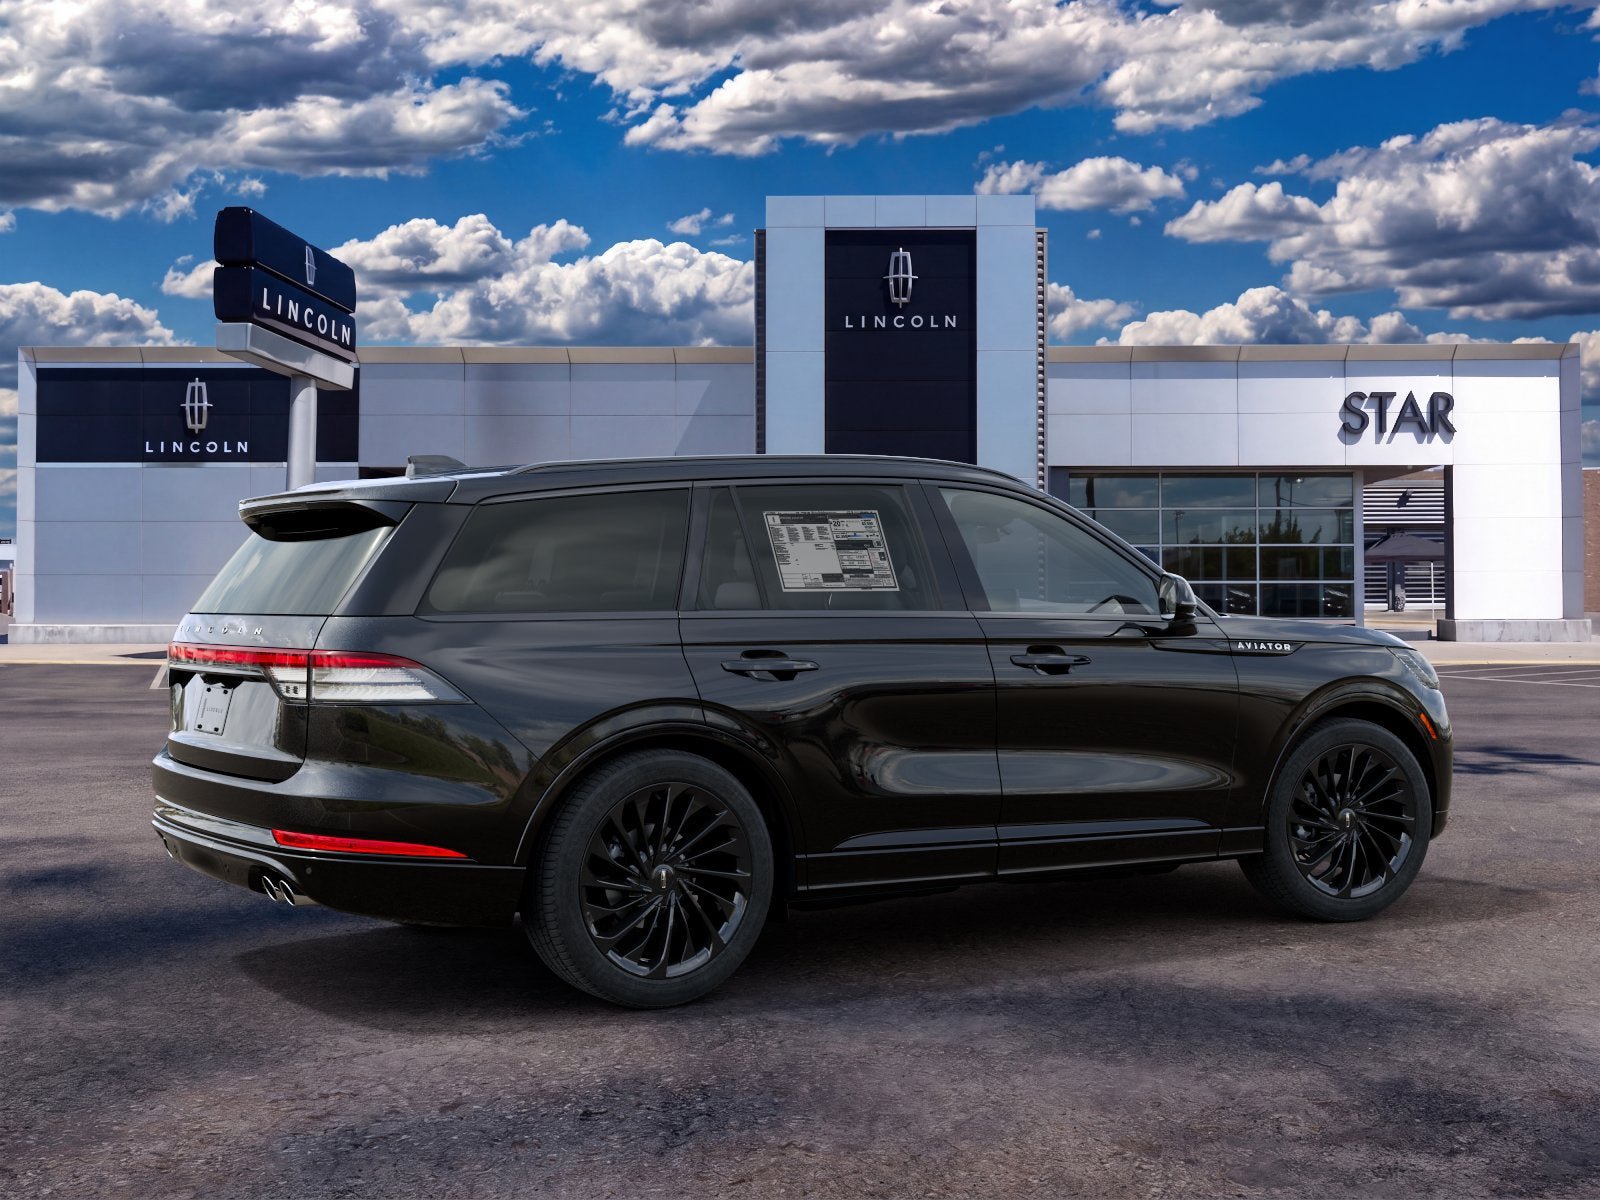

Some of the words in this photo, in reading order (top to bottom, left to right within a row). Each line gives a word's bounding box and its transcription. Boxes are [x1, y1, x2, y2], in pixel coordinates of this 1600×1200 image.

[262, 287, 351, 346] LINCOLN
[845, 315, 957, 328] LINCOLN
[1342, 390, 1457, 435] STAR
[145, 441, 248, 453] LINCOLN
[1237, 641, 1291, 651] AVIATOR
